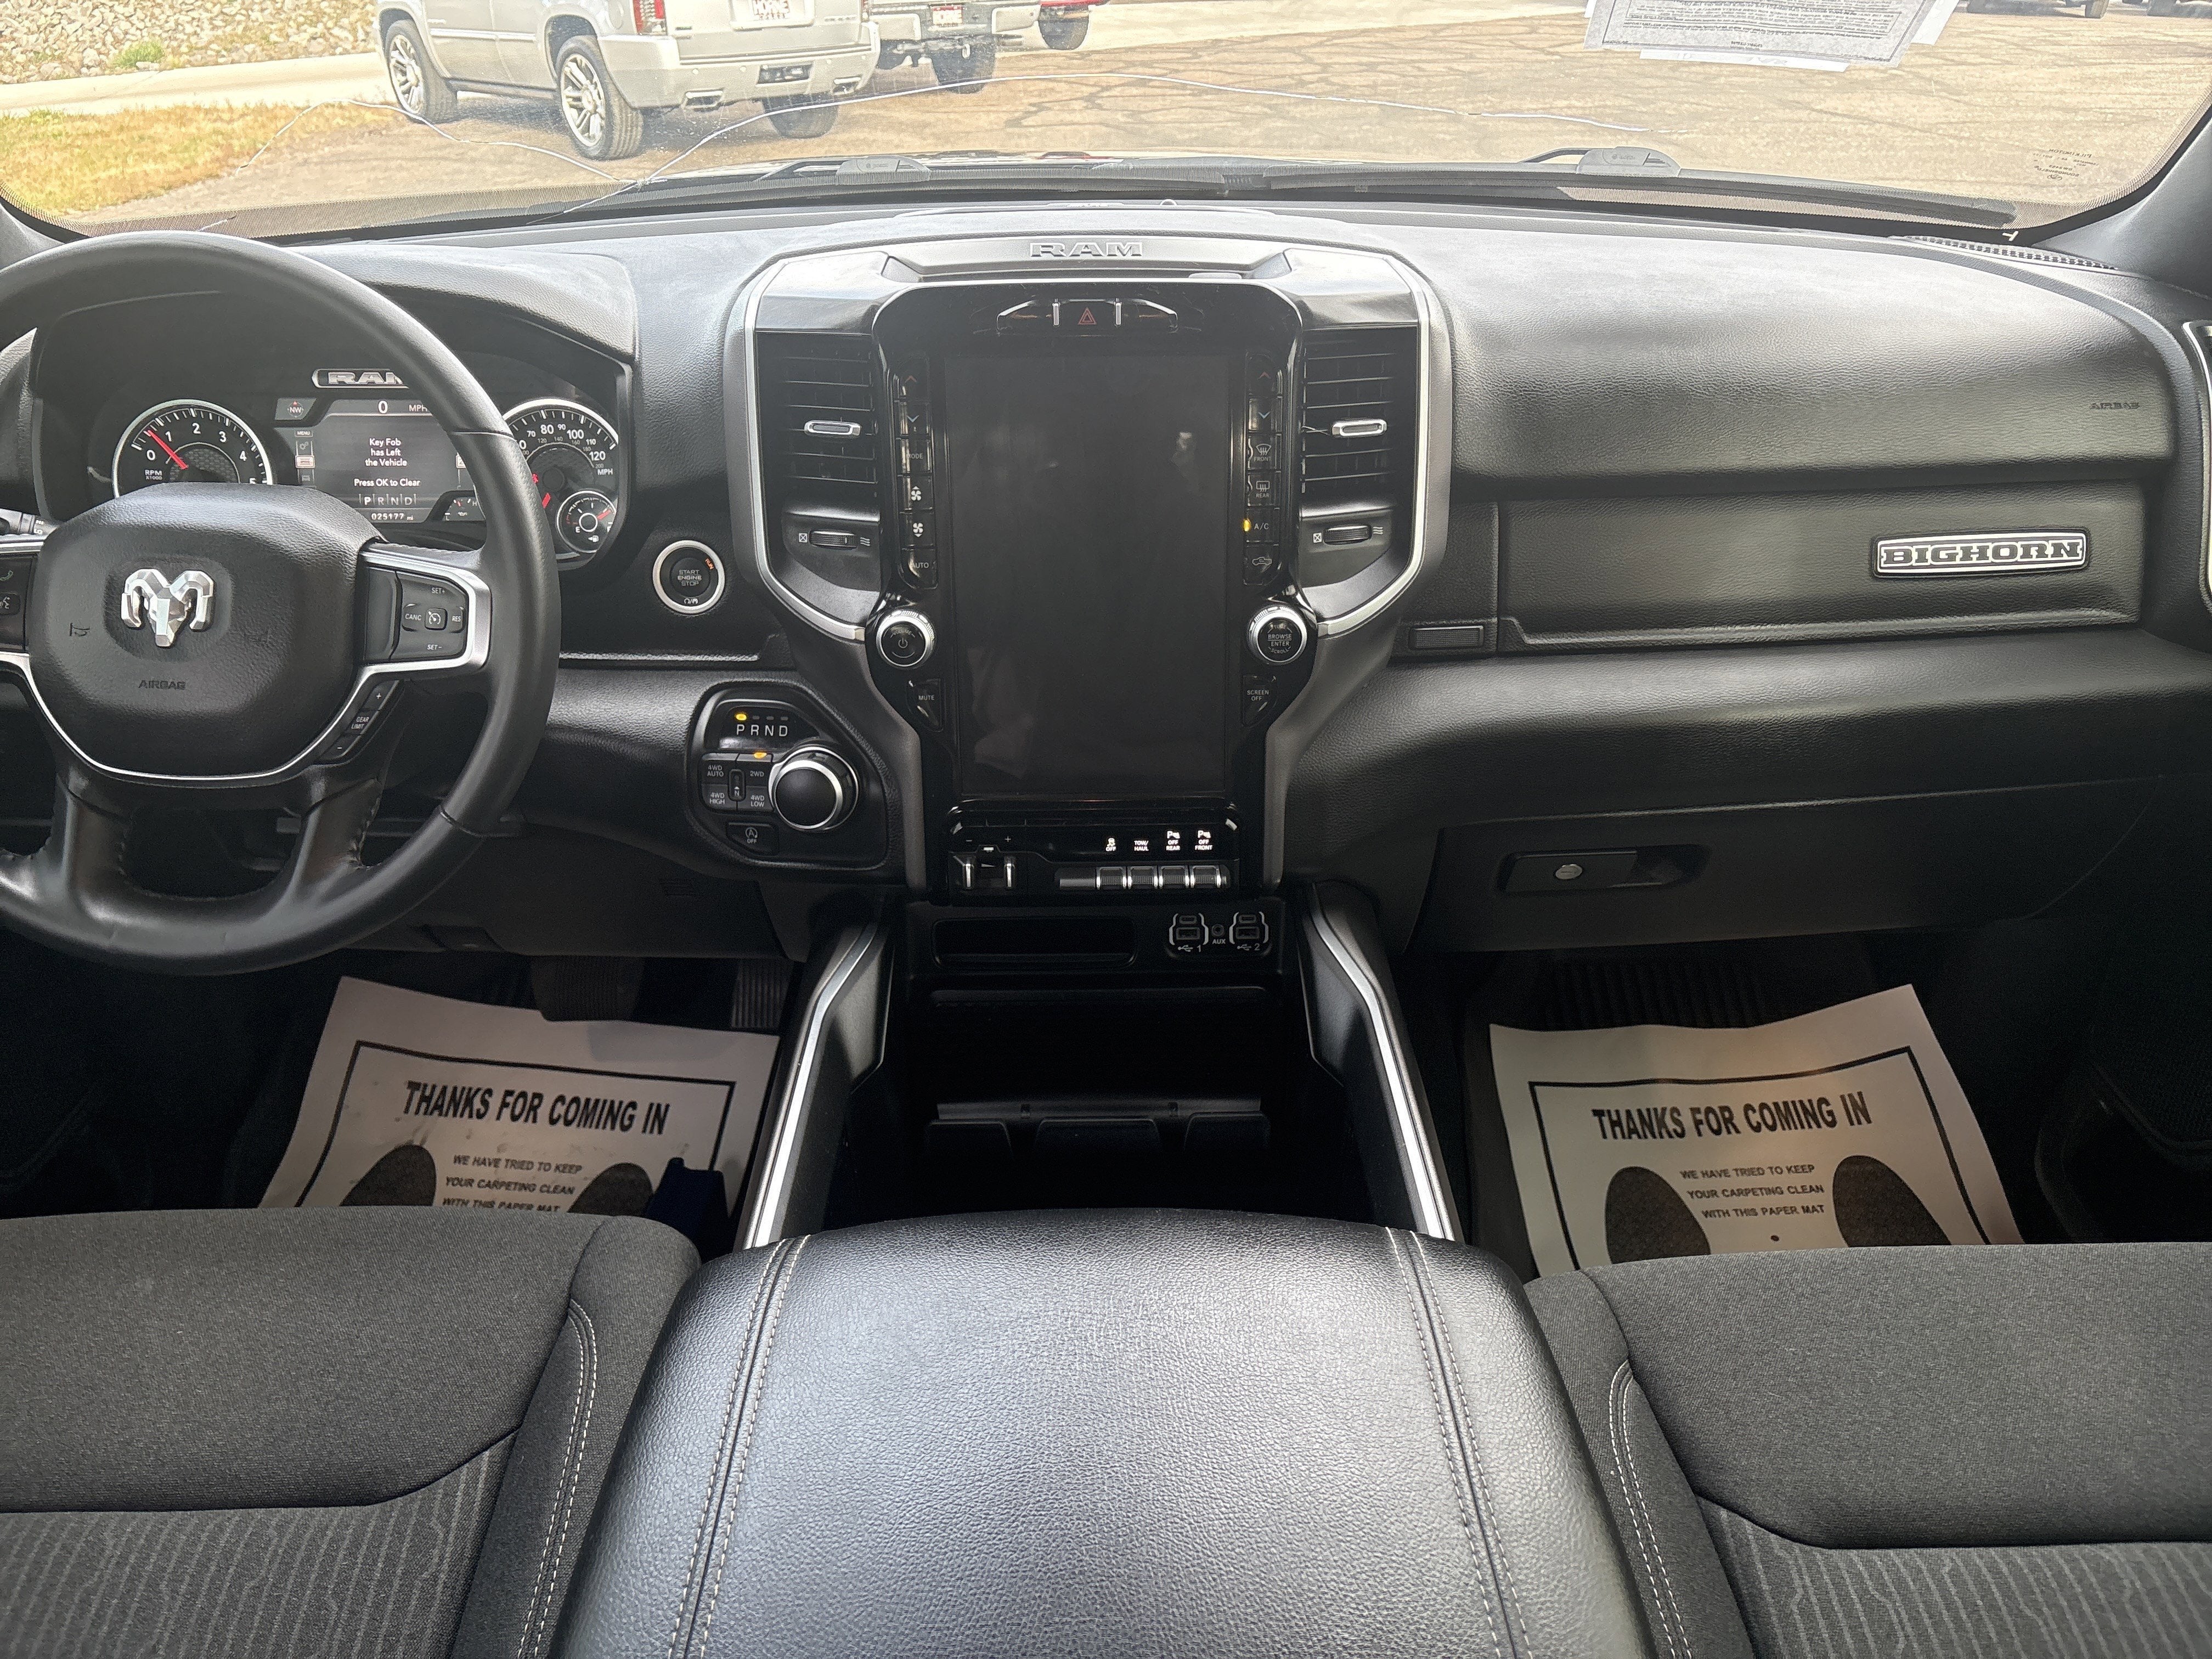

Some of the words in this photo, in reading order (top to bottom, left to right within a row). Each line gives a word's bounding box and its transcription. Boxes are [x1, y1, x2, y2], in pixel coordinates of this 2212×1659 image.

[1030, 242, 1143, 257] RAM
[379, 400, 388, 414] 0
[192, 422, 201, 434] 2
[540, 424, 554, 435] 80
[165, 431, 172, 442] 1
[219, 431, 227, 443] 3
[566, 429, 584, 440] 100
[369, 438, 384, 447] Key
[386, 438, 401, 447] Fob
[146, 450, 156, 461] 0
[239, 450, 247, 461] 4
[385, 448, 401, 456] Left
[589, 451, 606, 461] 120
[379, 459, 408, 467] Vehicle
[354, 478, 375, 487] Press
[399, 478, 421, 487] Clear
[364, 496, 371, 505] P
[377, 497, 385, 505] R
[1254, 522, 1269, 531] A/C
[1881, 539, 2083, 567] BIGHORN
[138, 680, 187, 690] AIRBAG
[736, 724, 746, 736] P
[750, 724, 760, 736] R
[764, 725, 775, 737] N
[778, 725, 788, 737] D
[1197, 945, 1201, 953] 1
[1254, 943, 1261, 951] 2
[403, 1080, 493, 1120] THANKS
[496, 1089, 544, 1124] FOR
[549, 1094, 638, 1132] COMING
[641, 1101, 671, 1135] IN
[1592, 1106, 1686, 1141] THANKS
[1689, 1105, 1741, 1137] FOR
[1742, 1096, 1838, 1133] COMING
[1839, 1091, 1874, 1126] IN
[453, 1154, 471, 1165] WE
[472, 1155, 501, 1169] HAVE
[504, 1158, 534, 1171] TRIED
[536, 1160, 552, 1172] TO
[553, 1163, 583, 1175] KEEP
[1679, 1169, 1699, 1180] WE
[1701, 1167, 1731, 1180] HAVE
[1733, 1165, 1766, 1177] TRIED
[1768, 1165, 1784, 1176] TO
[1786, 1163, 1815, 1175] KEEP
[445, 1176, 475, 1189] YOUR
[477, 1178, 537, 1194] CARPETING
[539, 1182, 576, 1195] CLEAN
[1686, 1187, 1719, 1200] YOUR
[1722, 1186, 1785, 1199] CARPETING
[1787, 1183, 1825, 1195] CLEAN
[442, 1197, 471, 1208] WITH
[471, 1199, 496, 1210] THIS
[535, 1203, 561, 1212] MAT
[1701, 1207, 1731, 1220] WITH
[1733, 1206, 1758, 1218] THIS
[1760, 1204, 1799, 1217] PAPER
[1801, 1203, 1826, 1215] MAT
